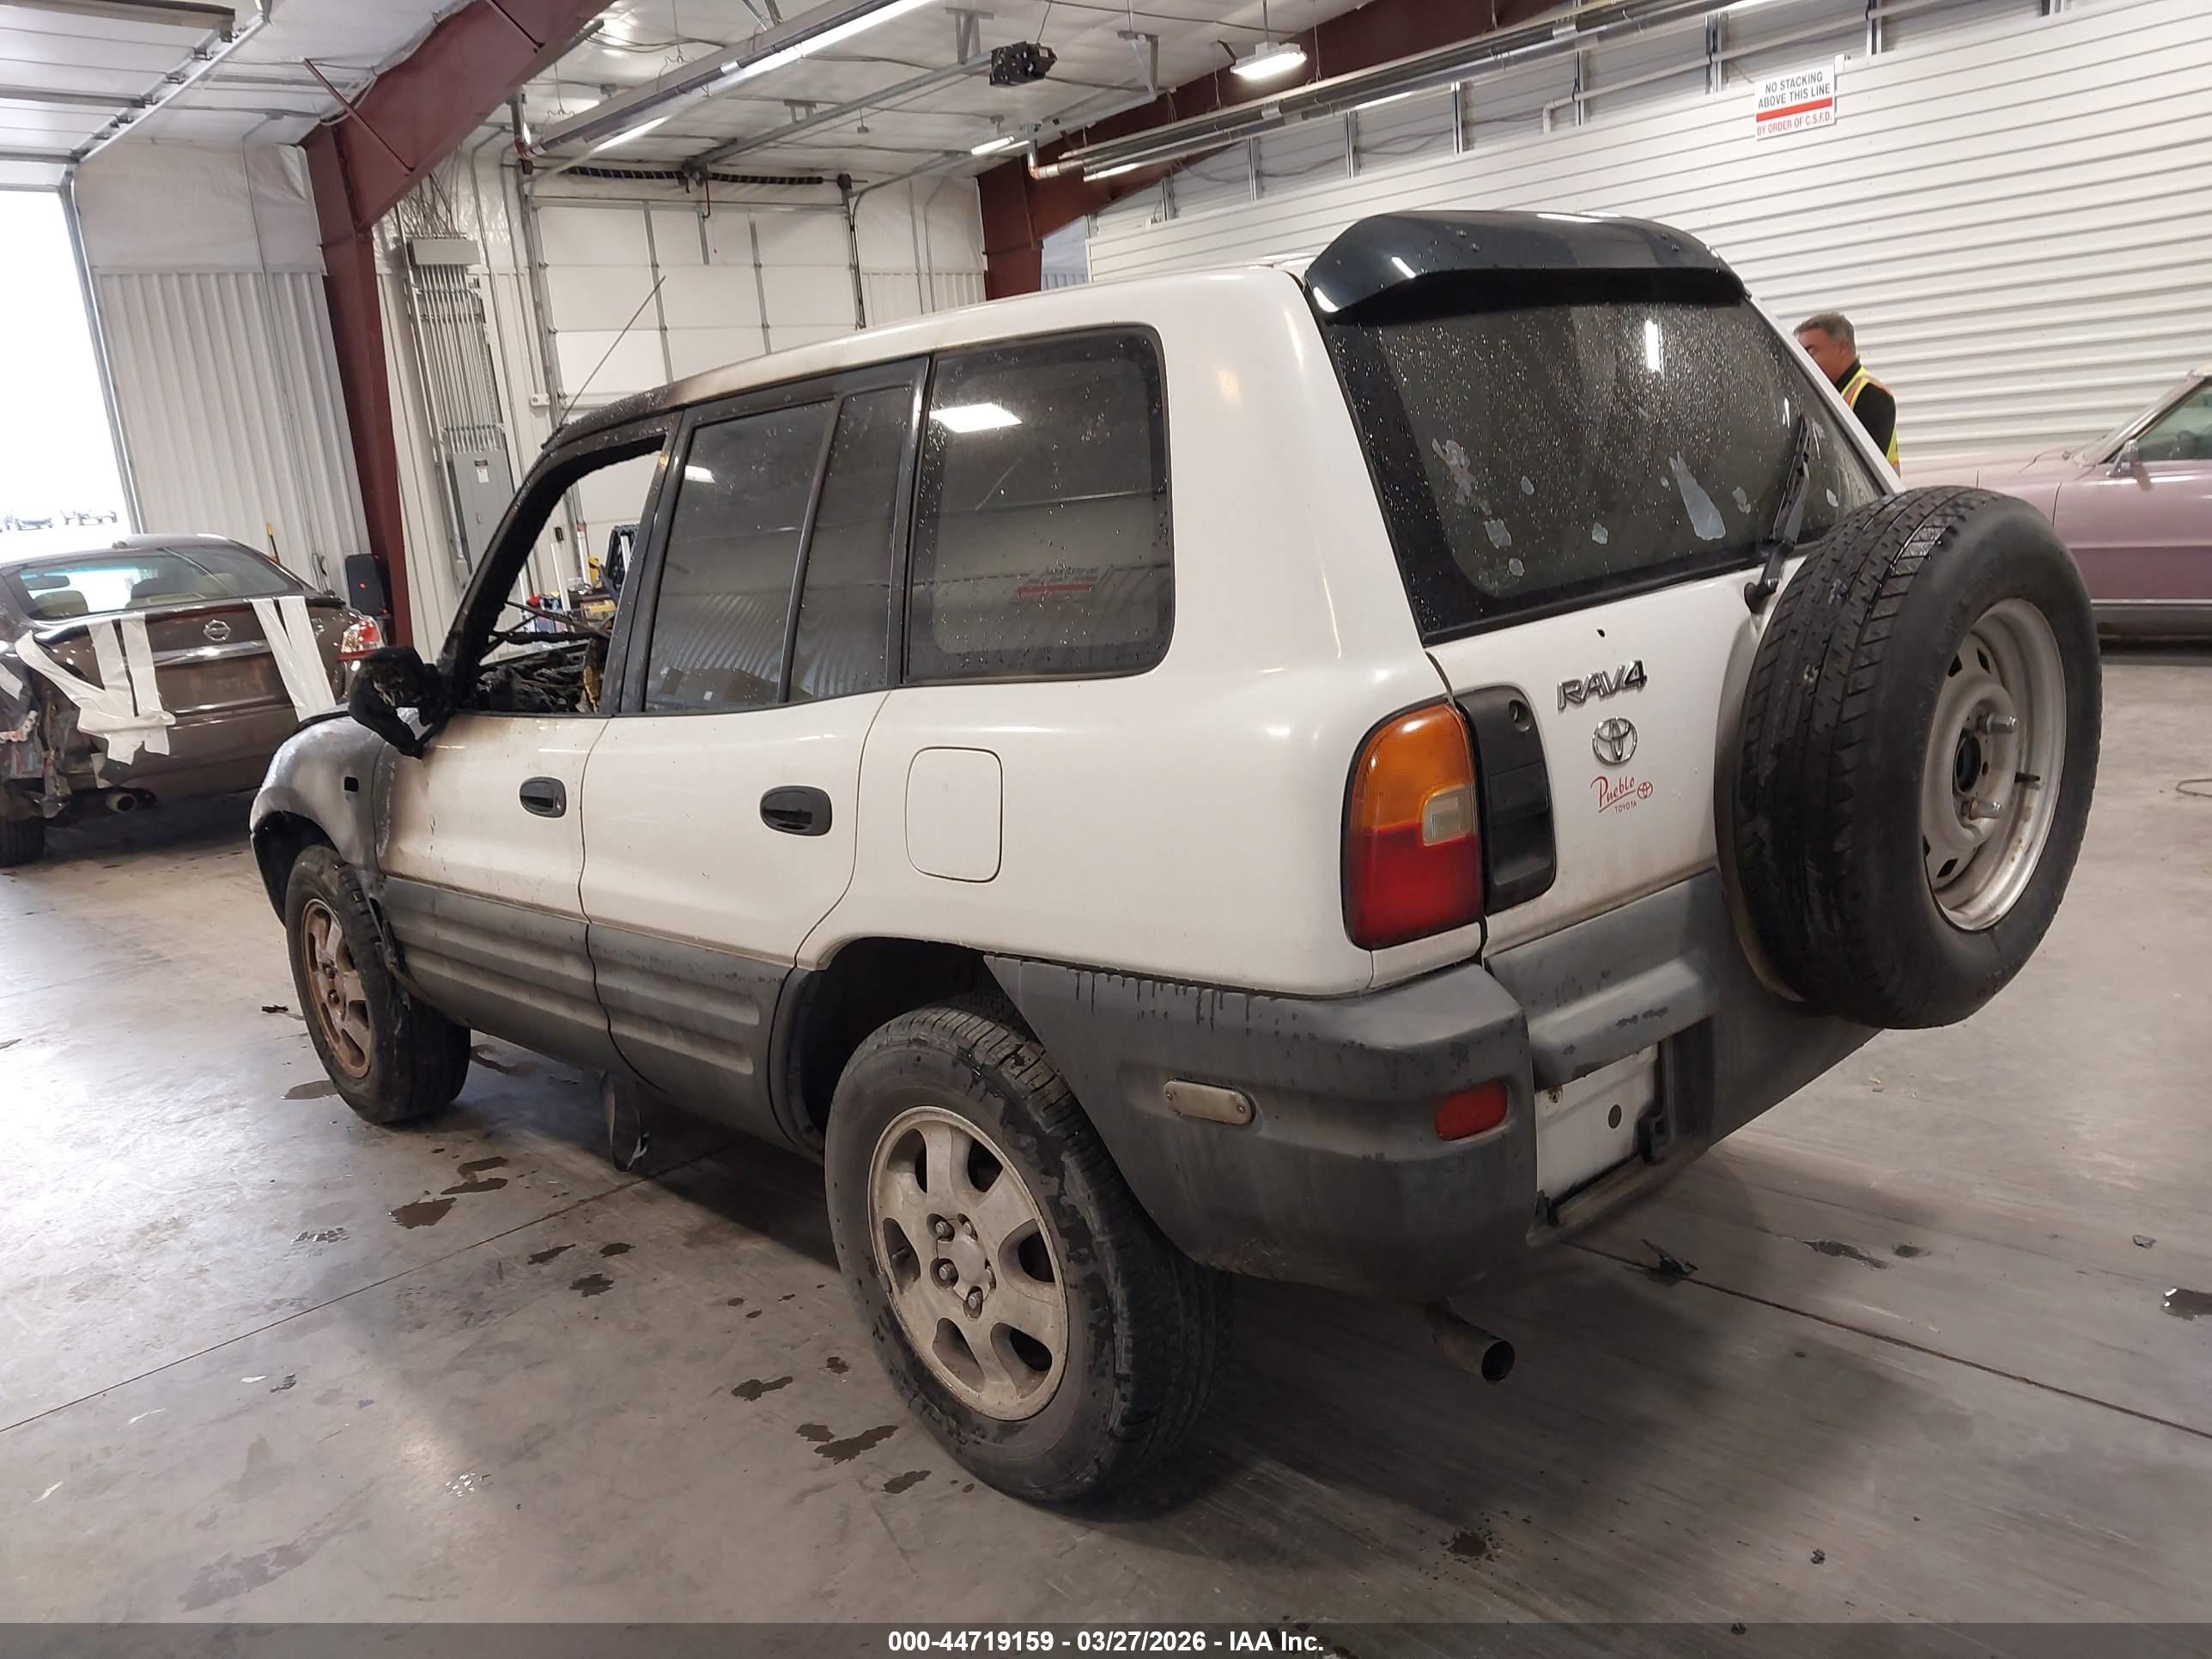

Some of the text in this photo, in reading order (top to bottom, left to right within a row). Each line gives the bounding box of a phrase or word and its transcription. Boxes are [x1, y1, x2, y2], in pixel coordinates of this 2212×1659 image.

[1765, 71, 1823, 94] NO STACKING
[1758, 82, 1831, 110] ABOVE THIS LINE
[1757, 125, 1766, 137] BY
[1768, 119, 1792, 133] ORDER
[1794, 117, 1803, 128] OF
[1557, 659, 1648, 711] RAV4
[1590, 775, 1635, 809] Pueblo
[1614, 800, 1638, 814] TOYOTA
